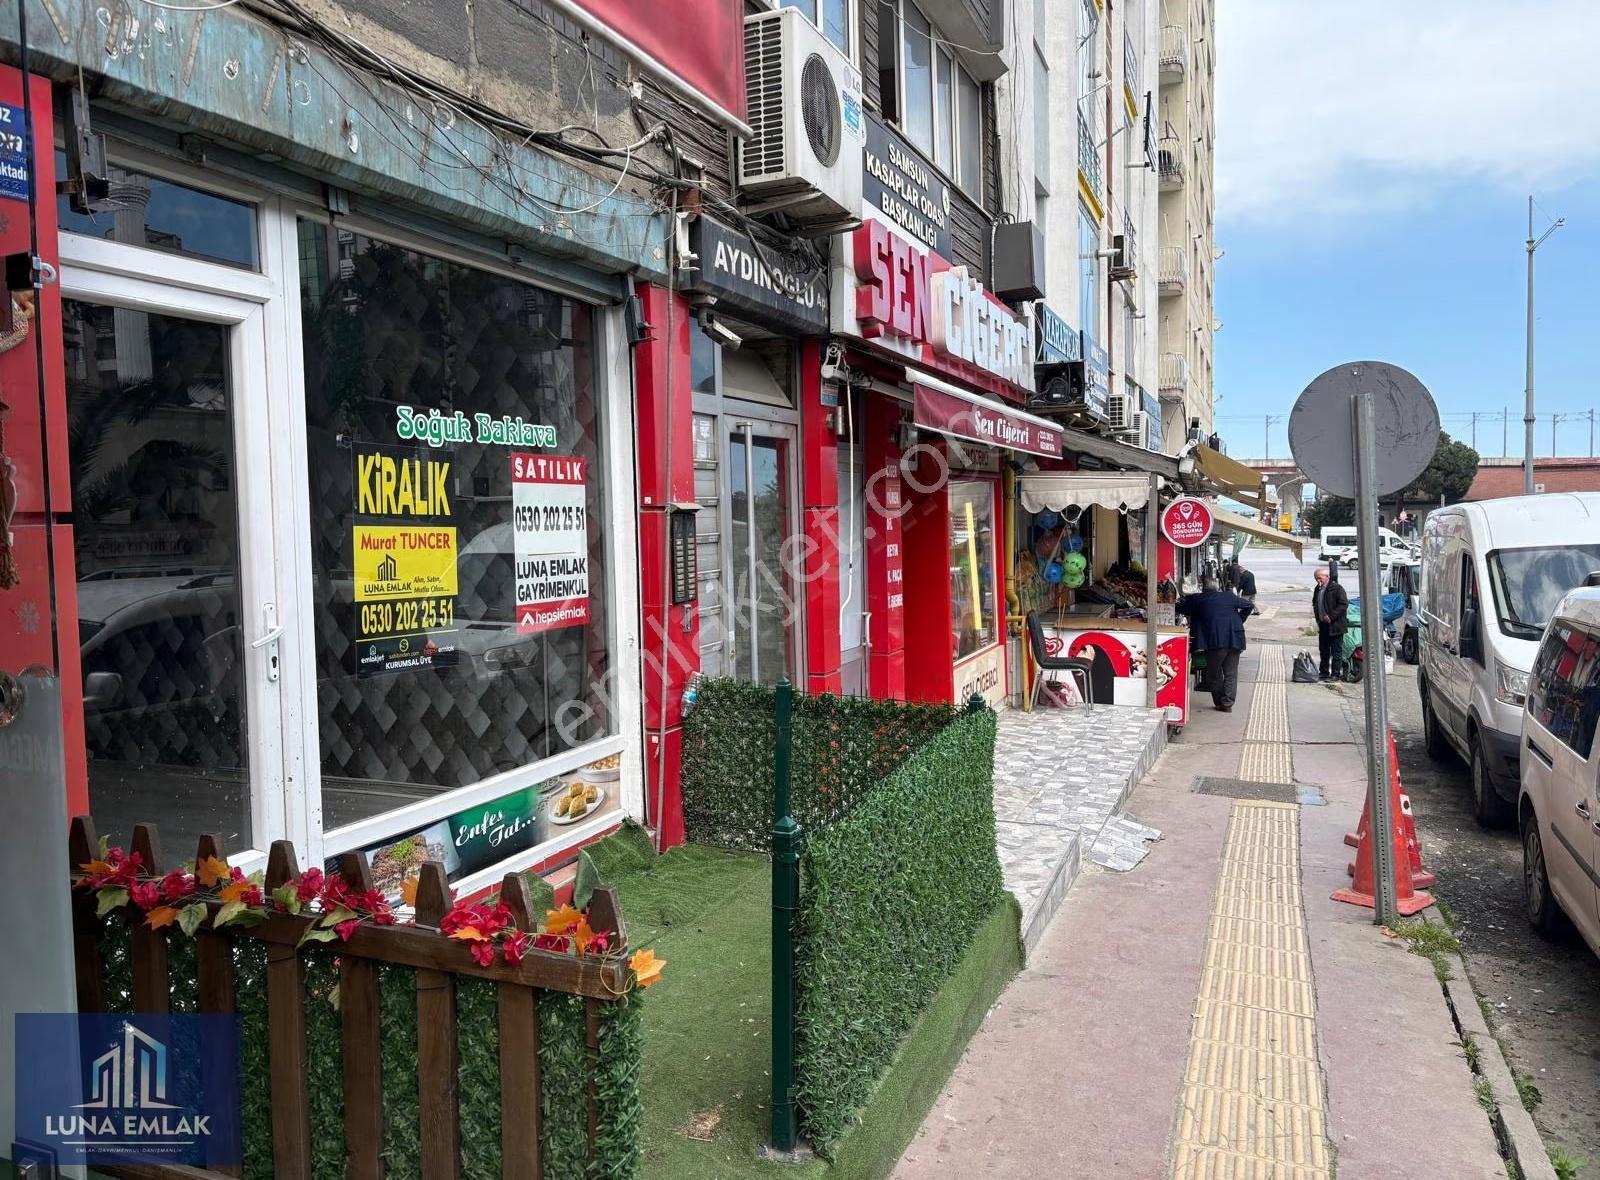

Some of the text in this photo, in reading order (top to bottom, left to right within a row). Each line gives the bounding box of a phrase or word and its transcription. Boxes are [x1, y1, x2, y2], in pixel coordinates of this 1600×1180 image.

[888, 143, 929, 190] SAMSUN
[865, 151, 945, 231] KASAPLAR ODASI
[881, 191, 937, 249] BAŞKANLIĞI
[853, 218, 934, 345] ŞEN
[396, 405, 558, 449] Soğuk Baklava
[974, 410, 994, 436] Şen
[514, 457, 583, 481] SATILIK
[515, 505, 585, 532] 0530 202 25 51
[1187, 520, 1203, 528] GÜN
[360, 532, 451, 551] Murat TUNCER
[516, 557, 586, 580] LUNA EMLAK
[364, 582, 412, 594] LUNA EMLAK
[517, 576, 587, 602] GAYRİMENKUL
[361, 598, 454, 635] 0530 202 25 51
[535, 605, 586, 624] hepsiemlak
[385, 655, 432, 670] KURUMSAL ÜYE
[455, 809, 503, 847] Enfes
